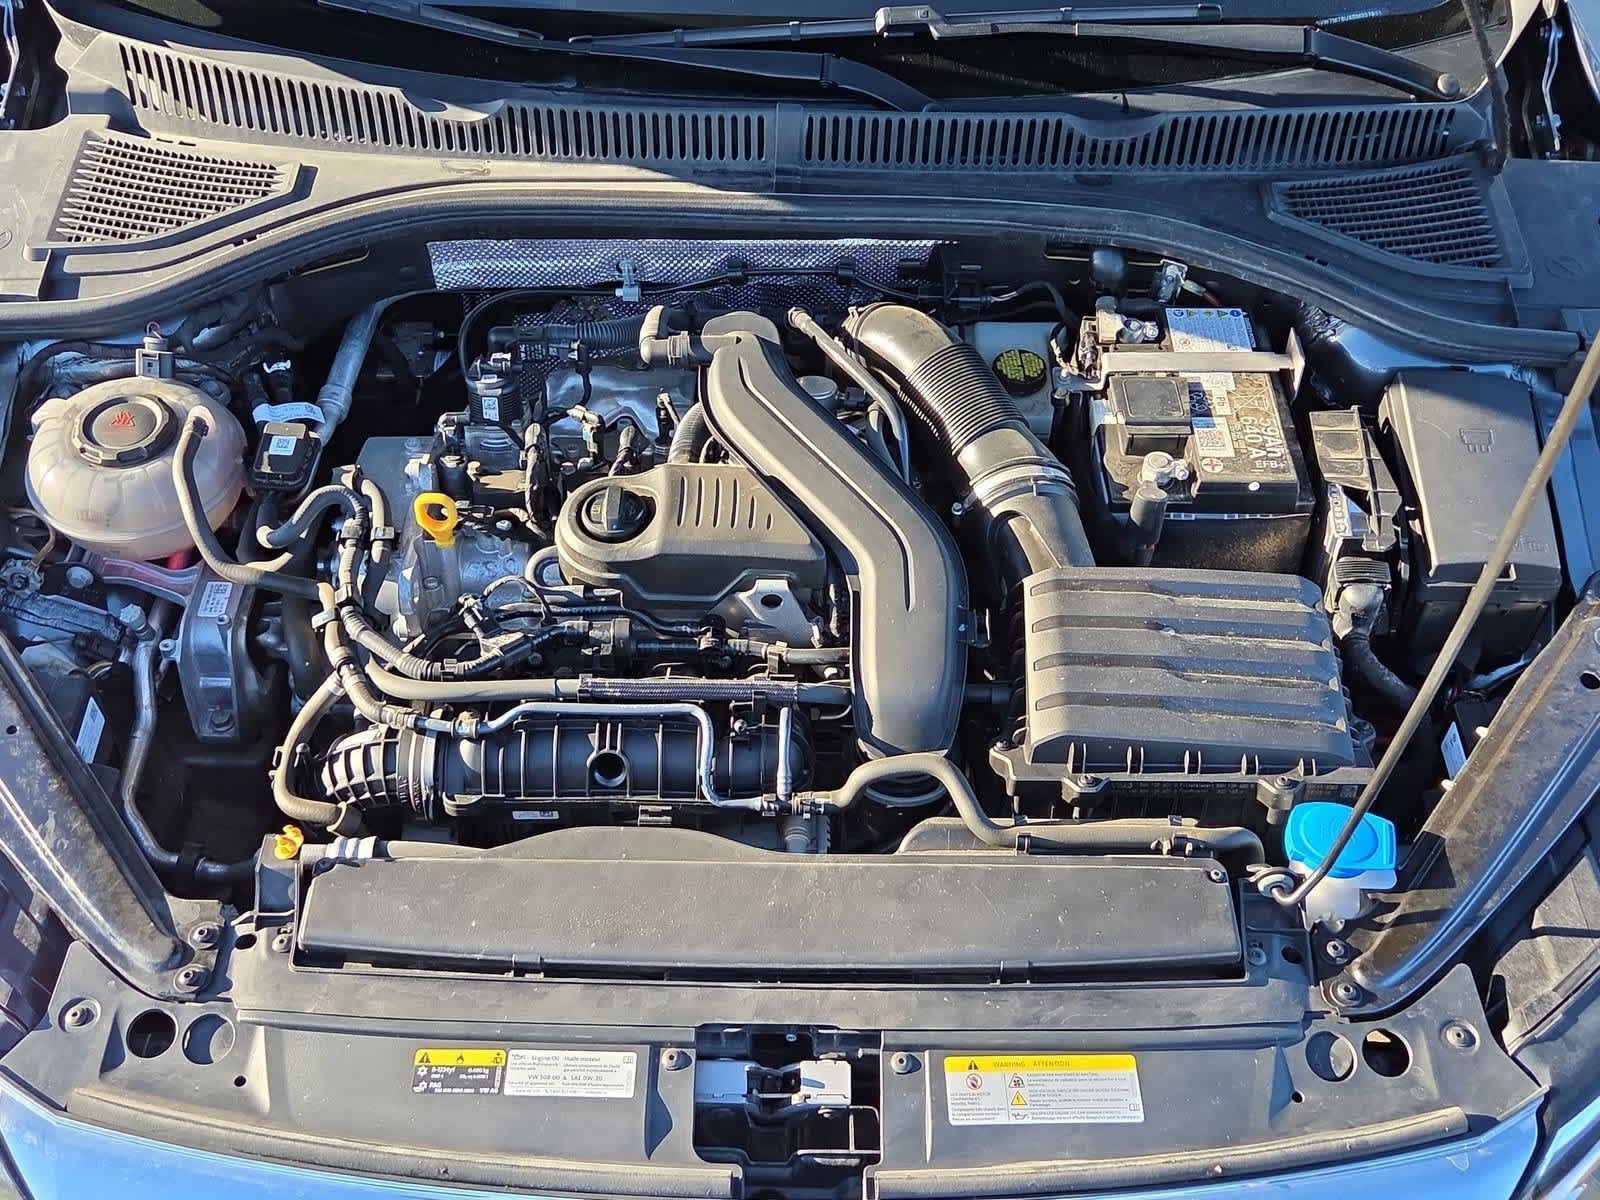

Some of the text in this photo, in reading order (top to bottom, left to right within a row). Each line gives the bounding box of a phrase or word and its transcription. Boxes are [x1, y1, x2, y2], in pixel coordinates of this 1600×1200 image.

[1241, 416, 1267, 459] 640 A
[1259, 416, 1285, 457] 59Ah
[1255, 460, 1286, 469] EFB+
